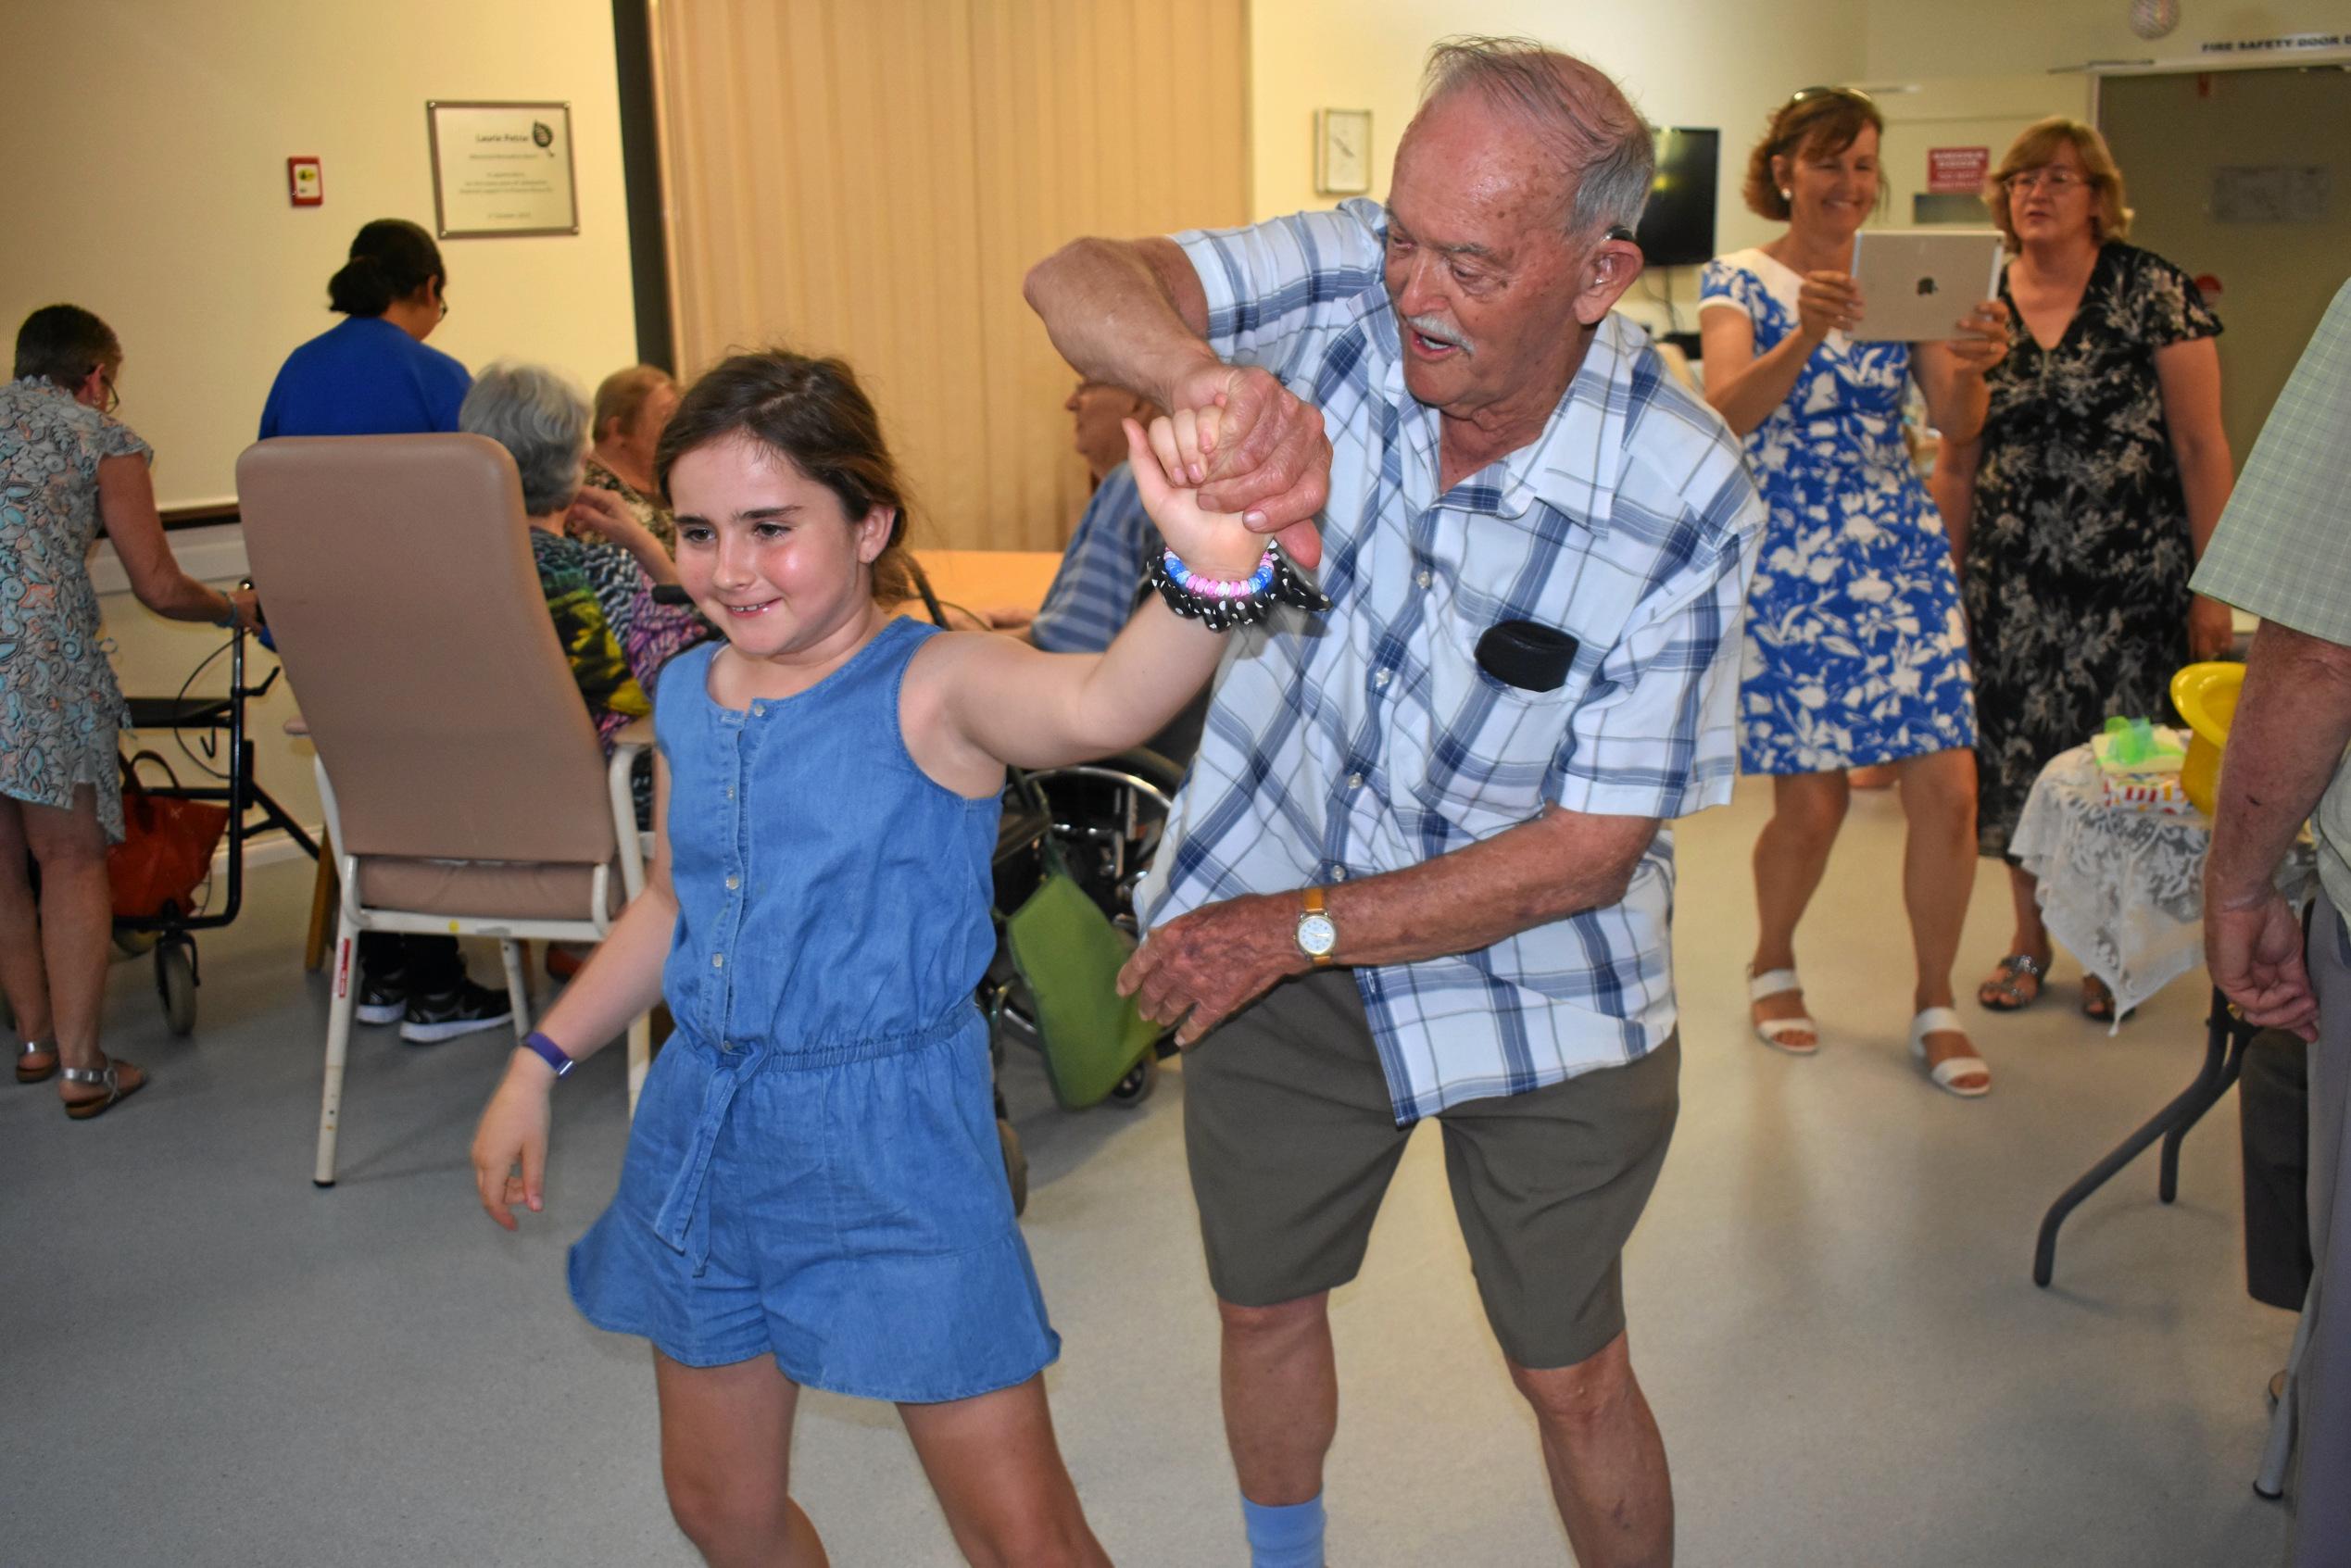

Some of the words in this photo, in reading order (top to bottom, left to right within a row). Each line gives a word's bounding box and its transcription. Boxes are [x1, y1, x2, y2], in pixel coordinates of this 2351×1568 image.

[2202, 43, 2232, 52] FIRE
[2238, 39, 2293, 50] SAFETY
[2297, 35, 2340, 46] DOOR
